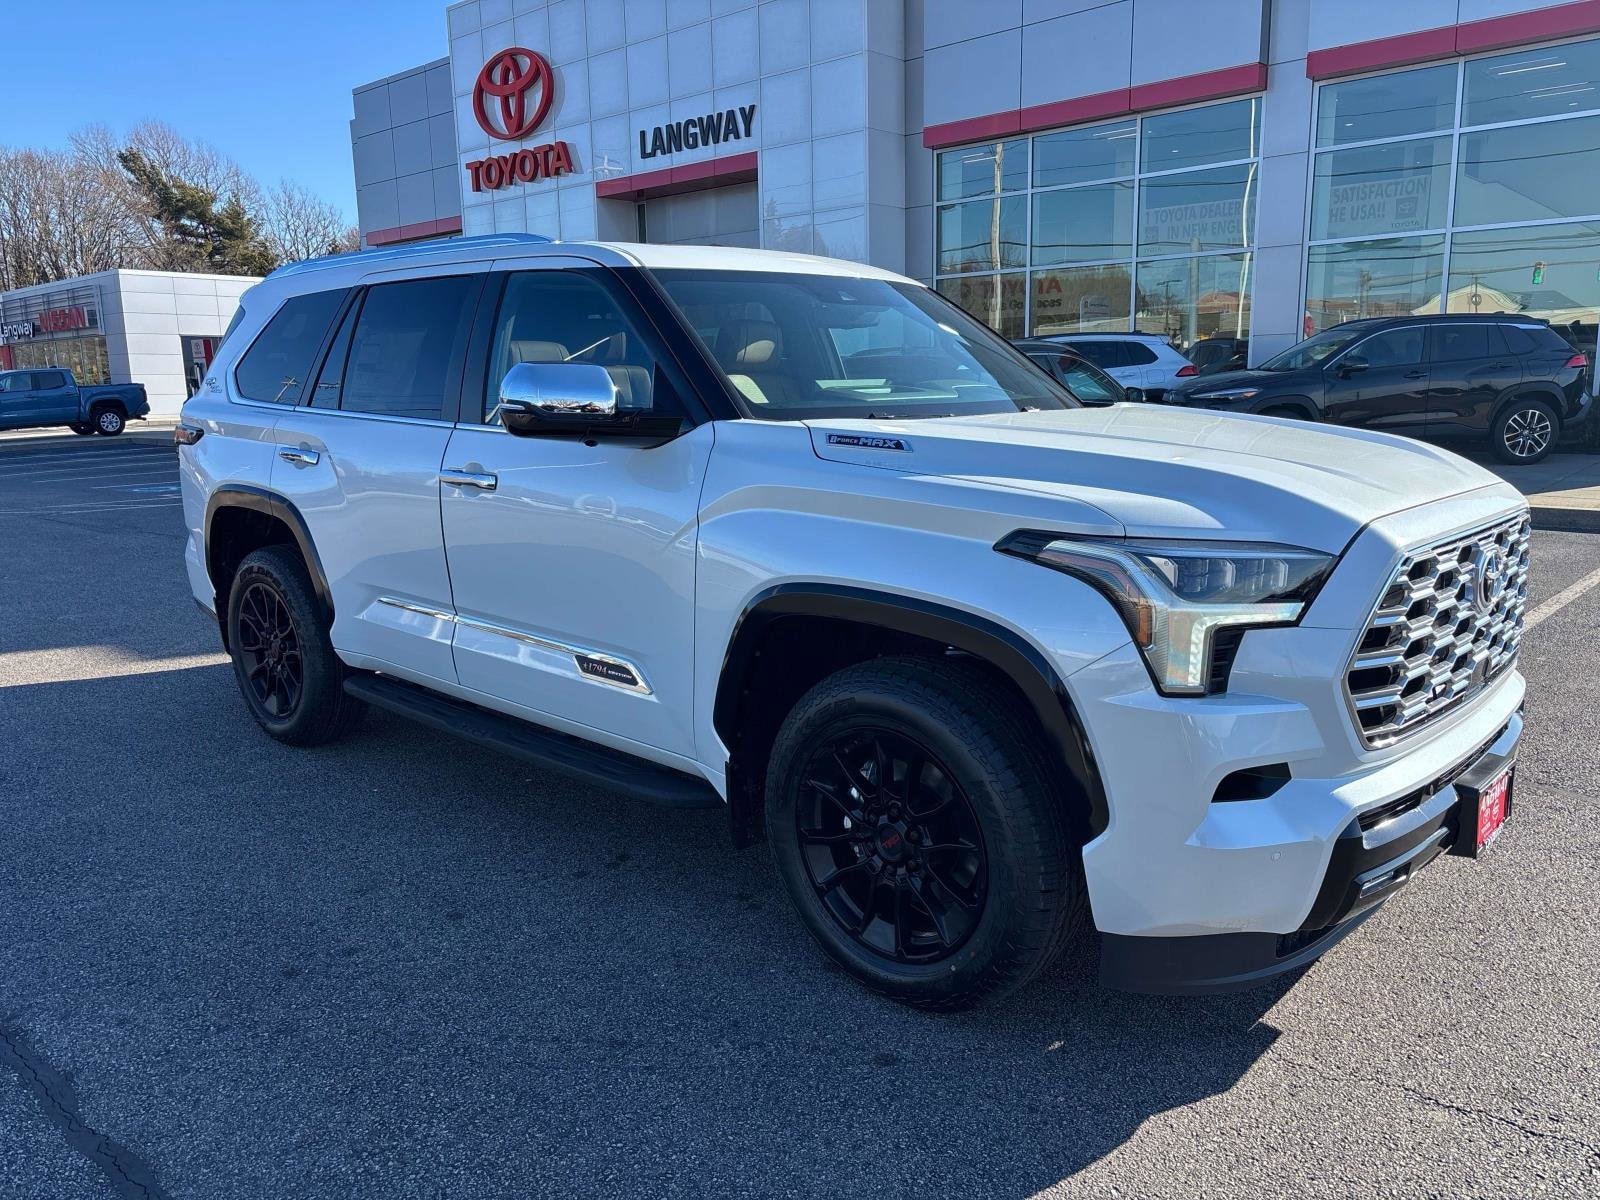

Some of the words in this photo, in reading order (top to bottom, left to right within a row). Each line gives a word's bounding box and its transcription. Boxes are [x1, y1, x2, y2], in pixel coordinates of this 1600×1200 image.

[639, 103, 756, 160] LANGWAY
[465, 140, 574, 192] TOYOTA
[1333, 177, 1427, 204] SATISFACTION
[1154, 206, 1197, 224] TOYOTA
[1350, 201, 1386, 221] USA!!
[1168, 224, 1178, 239] IN
[1183, 220, 1208, 238] NEW
[0, 321, 33, 339] Langway
[39, 305, 86, 333] NISSAN
[859, 438, 896, 448] MAX
